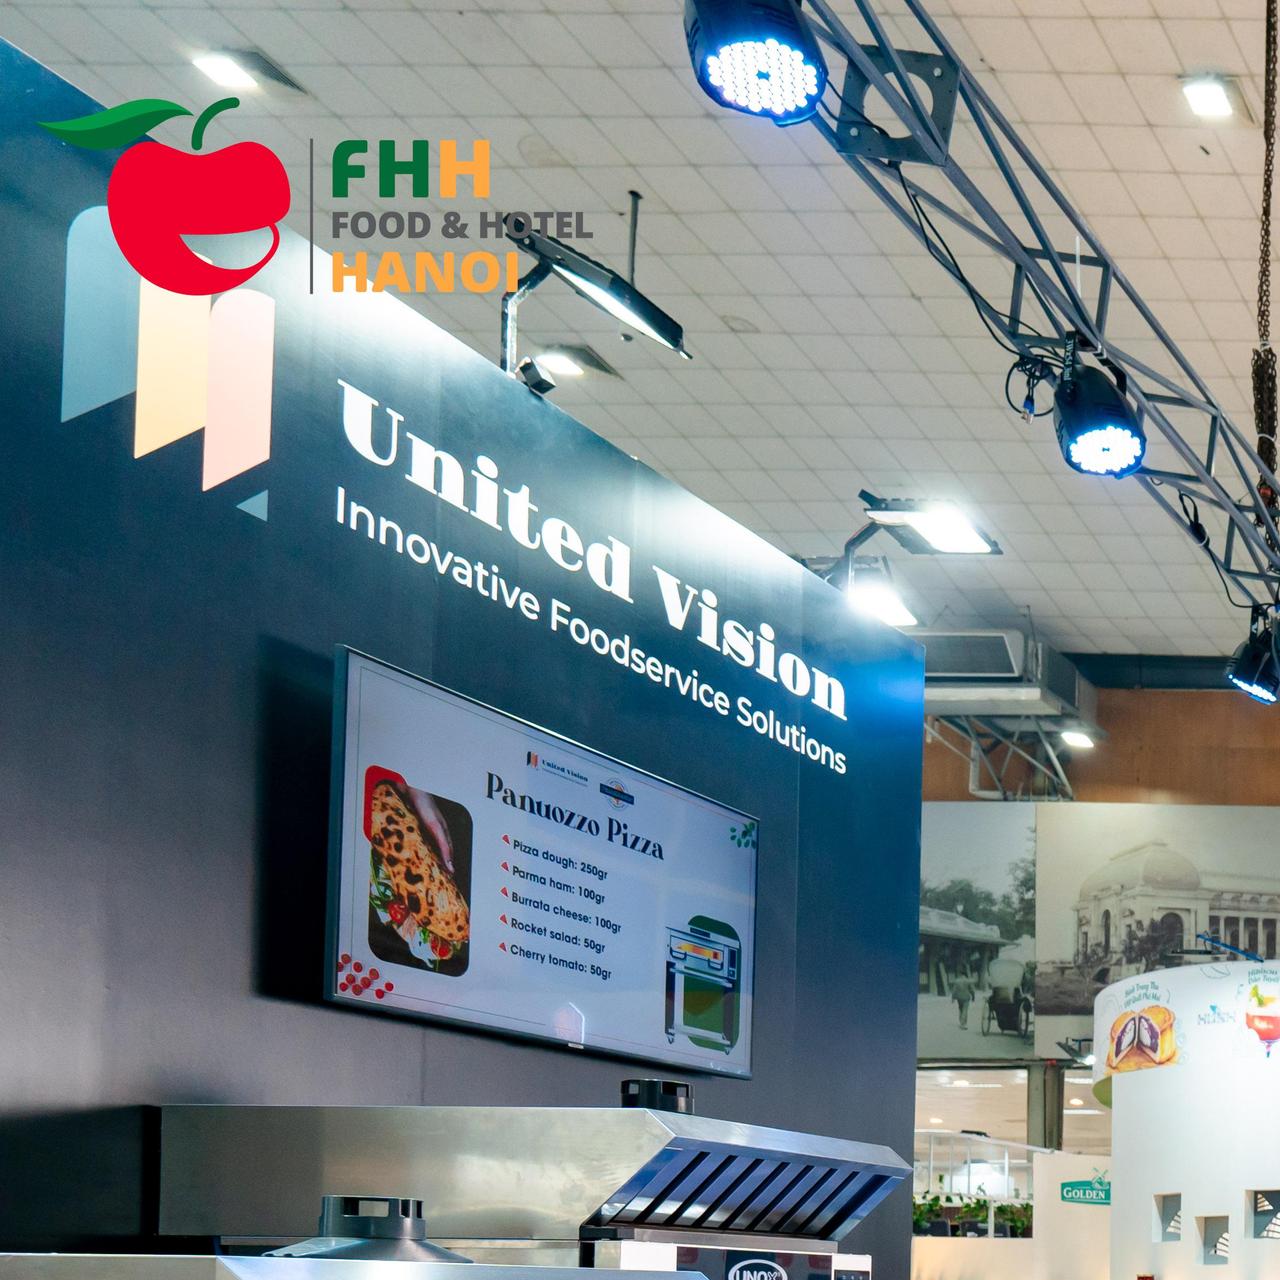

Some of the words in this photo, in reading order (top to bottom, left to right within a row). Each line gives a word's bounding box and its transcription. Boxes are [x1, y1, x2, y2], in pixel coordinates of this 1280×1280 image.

[337, 379, 633, 606] United
[652, 565, 848, 721] Vision
[337, 486, 541, 622] Innovative
[551, 600, 731, 718] Foodservice
[737, 697, 848, 776] Solutions
[486, 772, 600, 836] Panuozzo
[607, 817, 664, 860] Pizza
[513, 839, 539, 857] Pizza
[542, 849, 578, 870] dough:
[580, 862, 608, 880] 250gr
[513, 865, 546, 885] Parma
[550, 877, 575, 894] ham:
[578, 886, 605, 905] 100gr
[512, 892, 550, 912] Burrata
[553, 905, 592, 924] cheese:
[595, 916, 621, 934] 100gr
[511, 918, 547, 936] Rocket
[550, 928, 581, 947] salad:
[584, 936, 605, 954] 50gr
[510, 944, 545, 964] Cherry
[549, 954, 587, 973] tomato:
[590, 964, 612, 980] 50gr
[1063, 1187, 1105, 1199] GOLDEN
